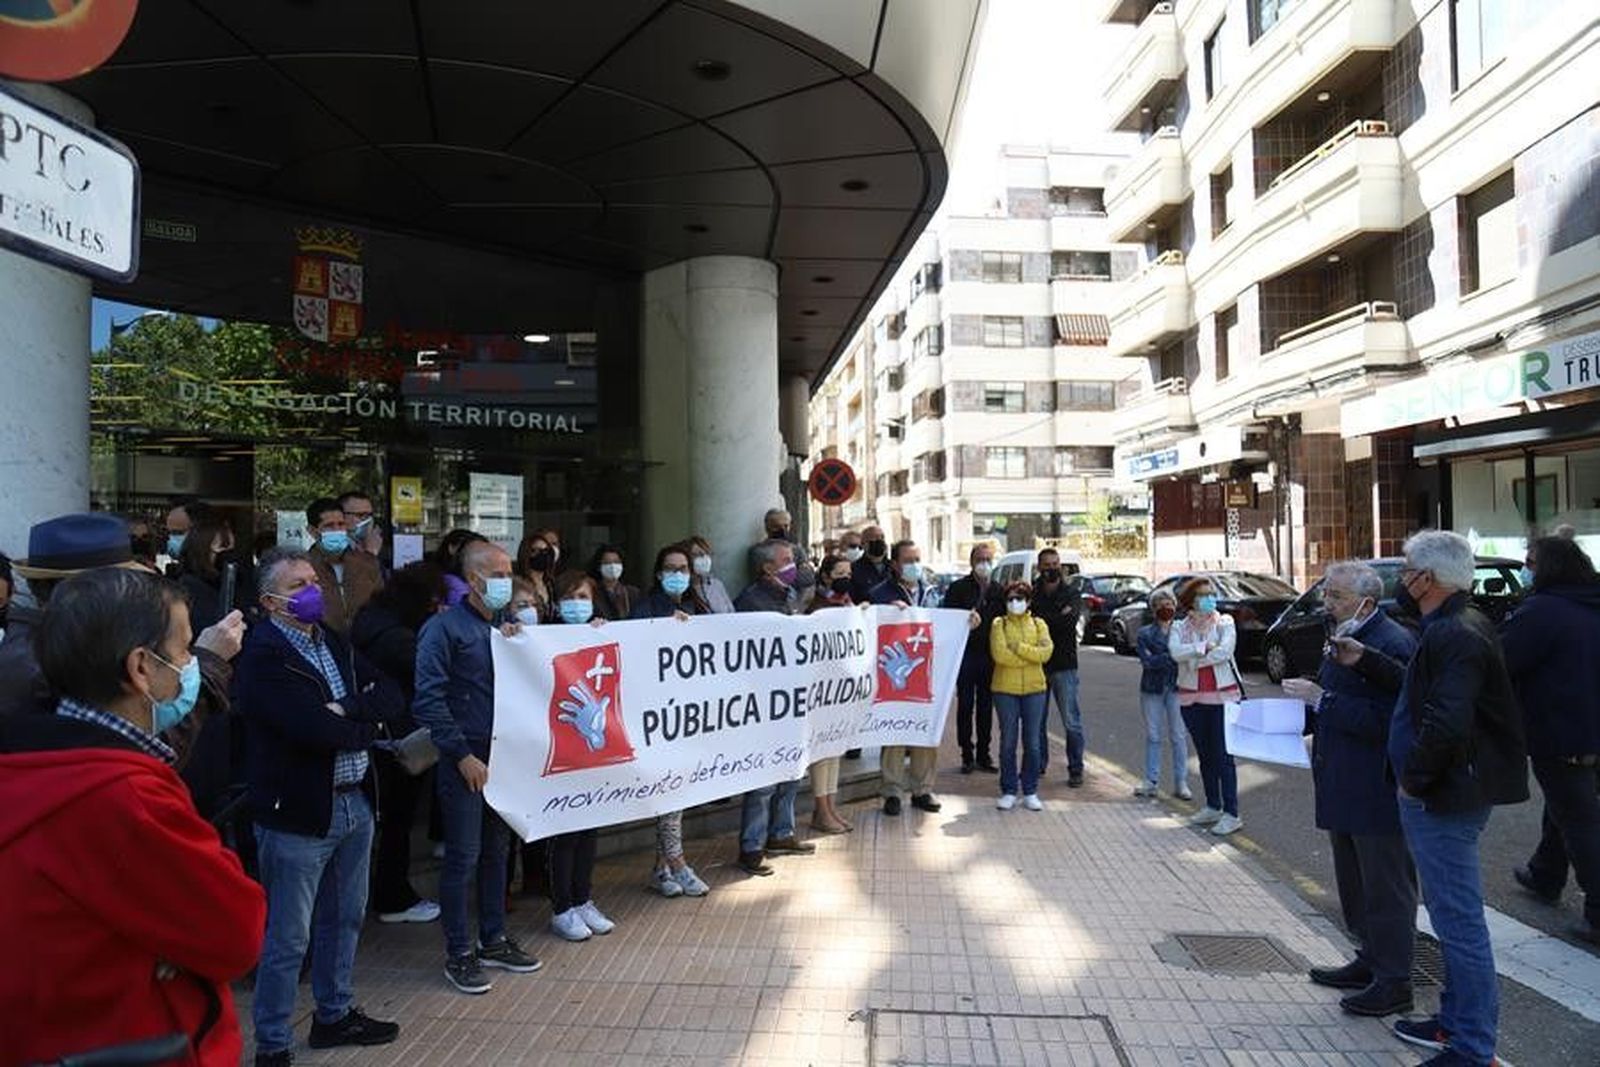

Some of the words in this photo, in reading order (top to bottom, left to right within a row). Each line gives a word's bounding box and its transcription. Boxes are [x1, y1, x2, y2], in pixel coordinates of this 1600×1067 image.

[180, 380, 397, 419] DELEGACIÓN
[410, 401, 584, 434] TERRITORIAL
[658, 641, 716, 683] POR
[724, 636, 787, 673] UNA
[795, 628, 865, 666] SANIDAD
[643, 692, 761, 747] PÚBLICA
[769, 686, 808, 722] DE
[806, 673, 873, 712] CALIDAD
[543, 767, 683, 813] movimiento
[689, 752, 765, 784] defensa
[859, 712, 929, 734] Zamora
